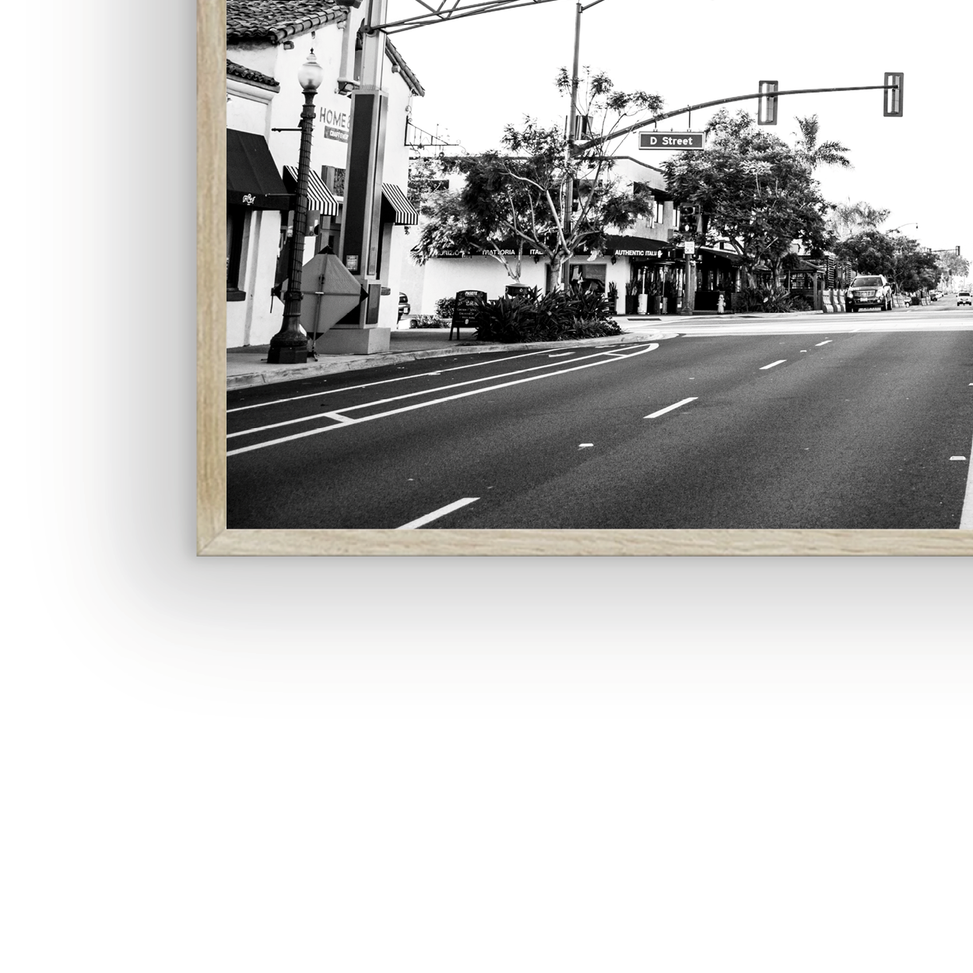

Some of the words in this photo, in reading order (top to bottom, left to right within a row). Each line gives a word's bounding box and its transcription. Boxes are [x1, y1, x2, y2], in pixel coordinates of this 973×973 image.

[319, 106, 347, 128] HOME
[650, 136, 658, 145] D
[662, 136, 693, 146] Street
